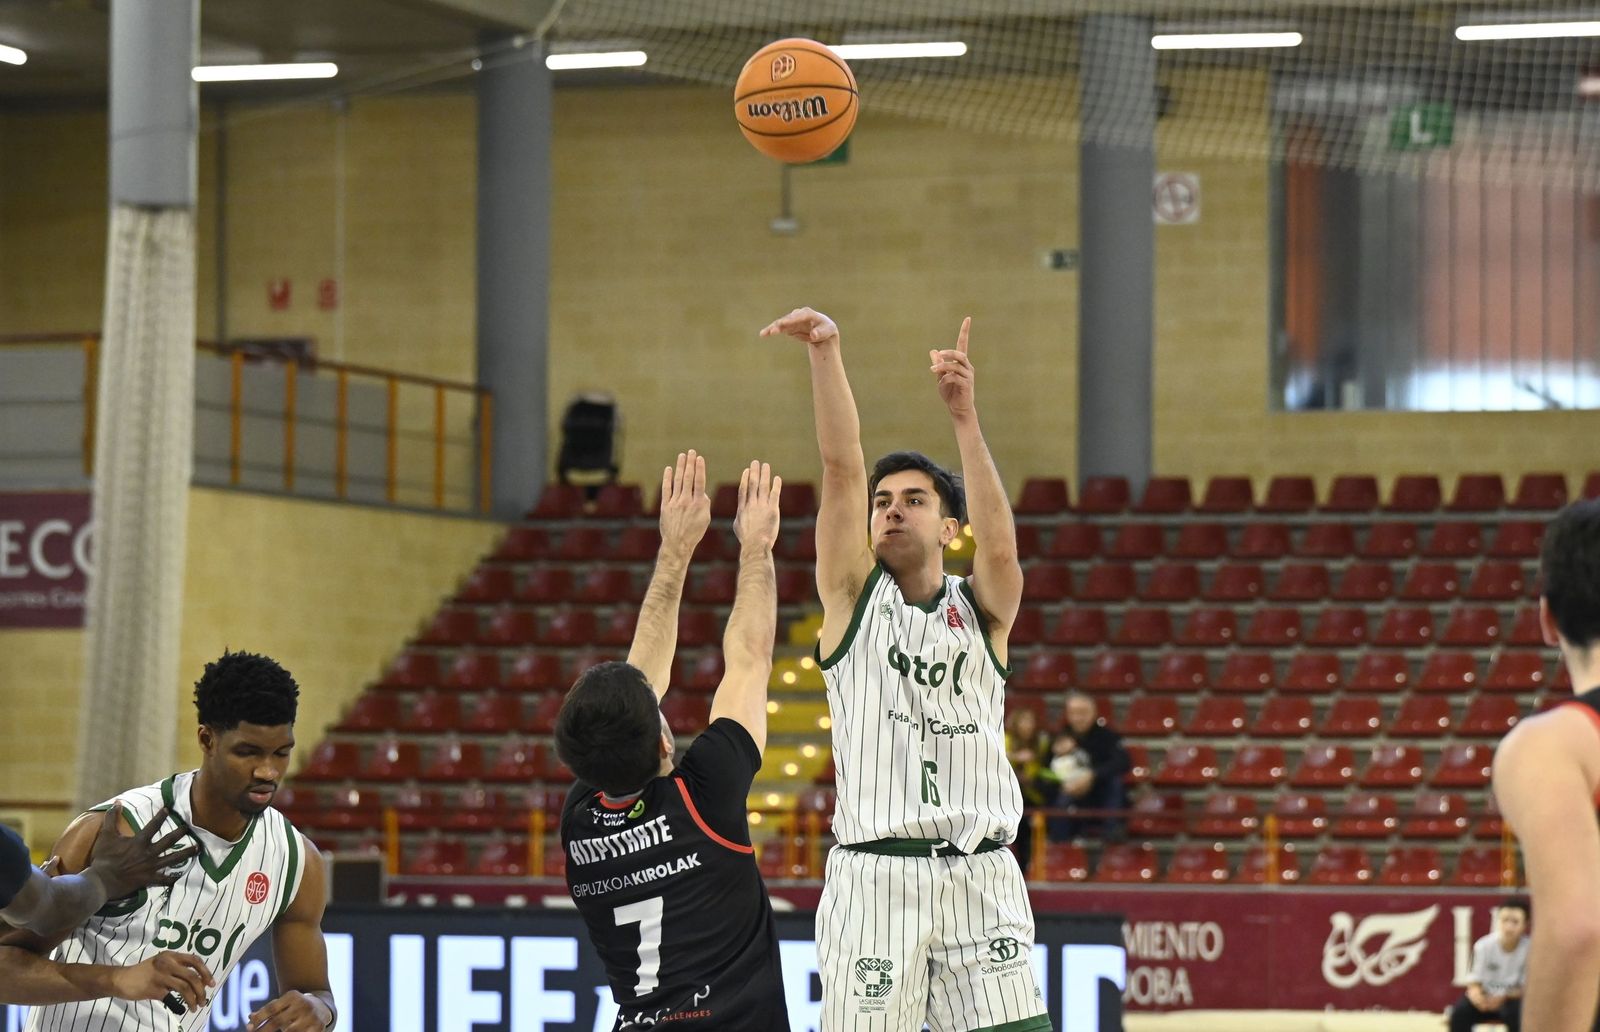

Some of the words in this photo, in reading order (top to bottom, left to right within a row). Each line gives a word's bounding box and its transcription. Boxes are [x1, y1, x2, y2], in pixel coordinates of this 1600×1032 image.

[748, 95, 828, 122] Wilson
[927, 718, 979, 739] Cajasol
[569, 815, 673, 866] AIZPITARTE
[613, 896, 663, 997] 7
